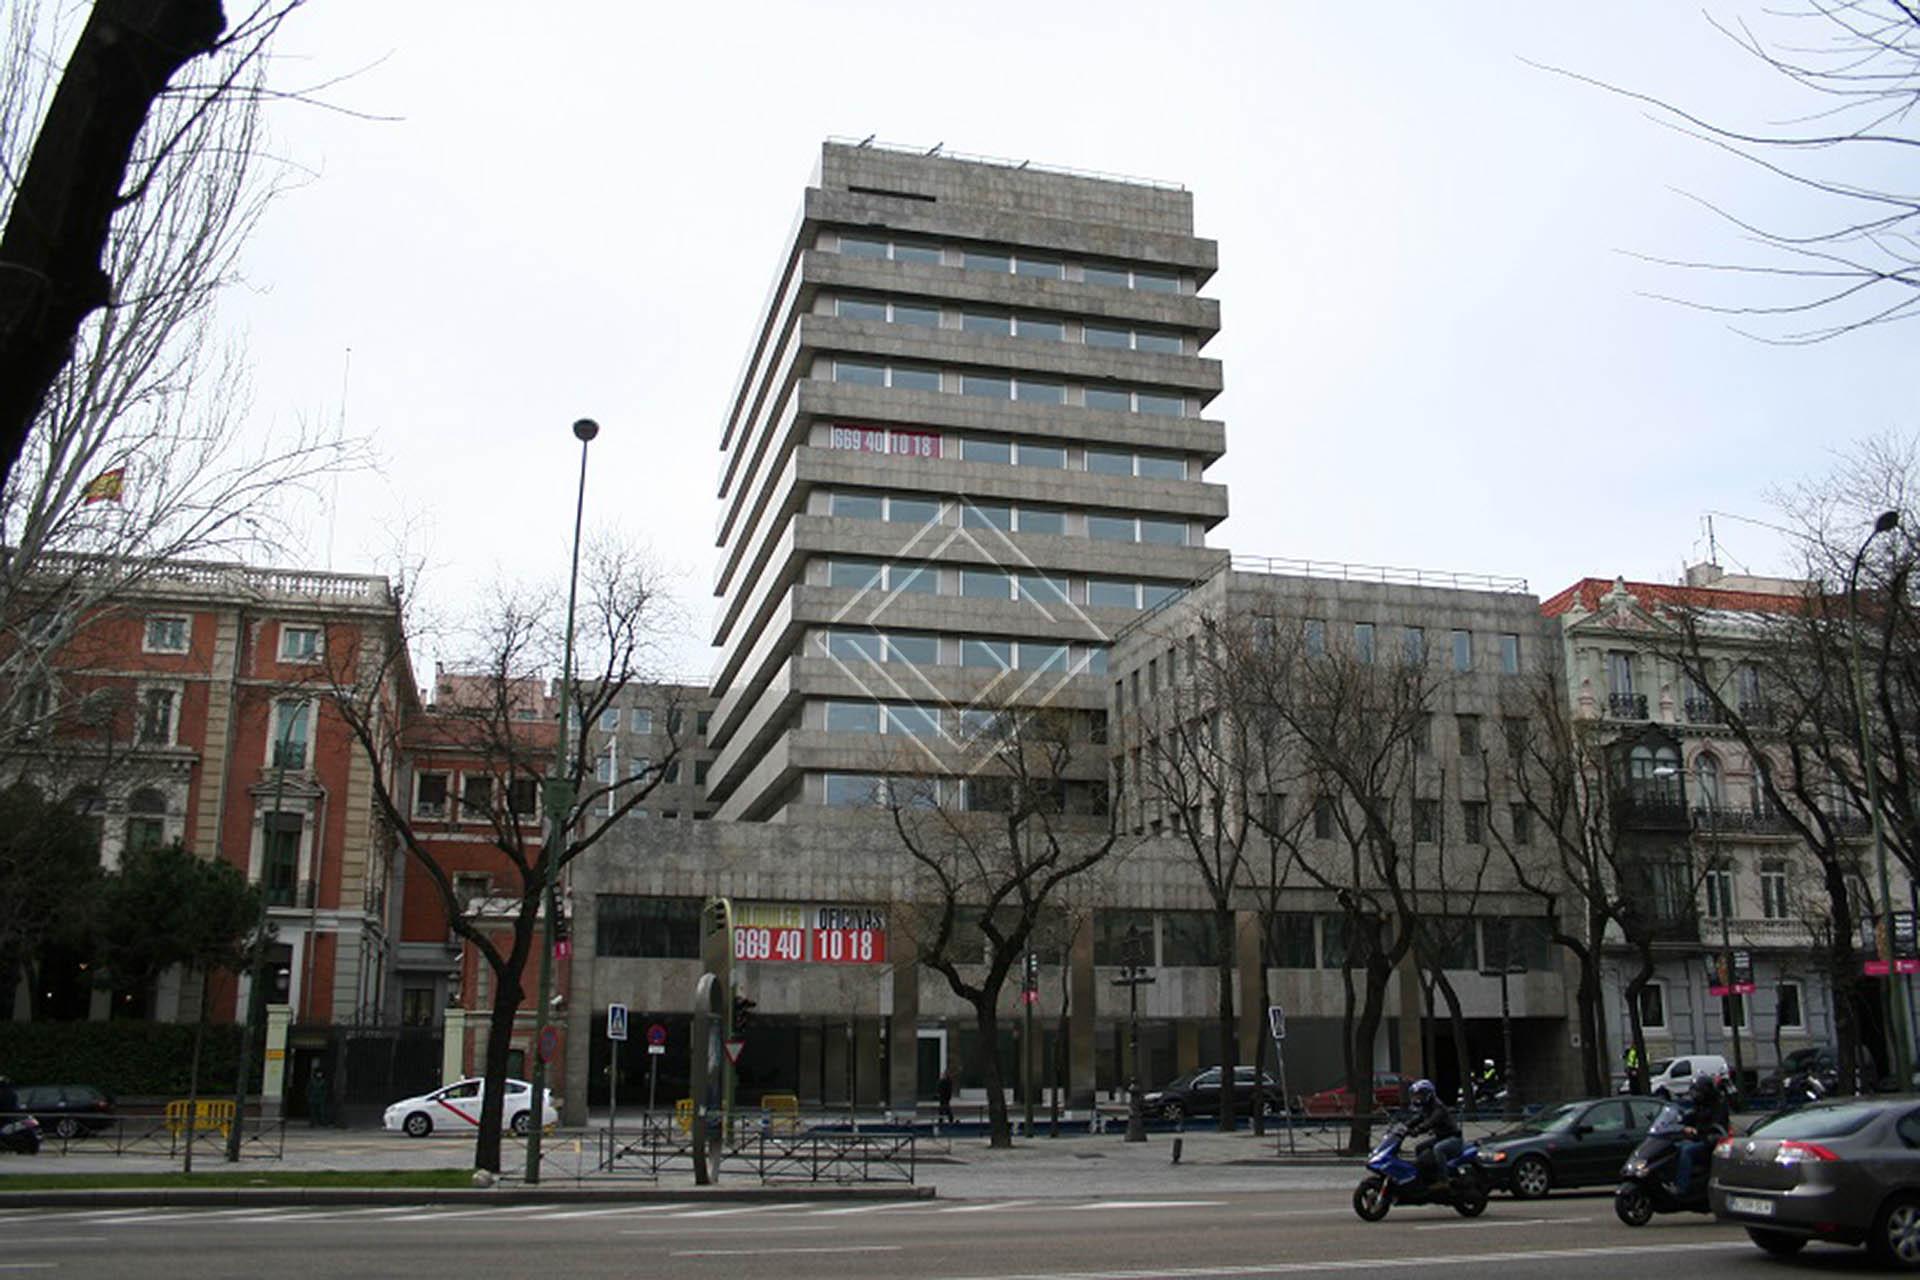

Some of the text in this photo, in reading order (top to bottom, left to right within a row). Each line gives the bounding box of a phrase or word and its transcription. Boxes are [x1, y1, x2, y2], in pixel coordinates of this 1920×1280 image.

[835, 428, 931, 457] 669 40 10 18
[735, 929, 873, 961] 669 40 10 18
